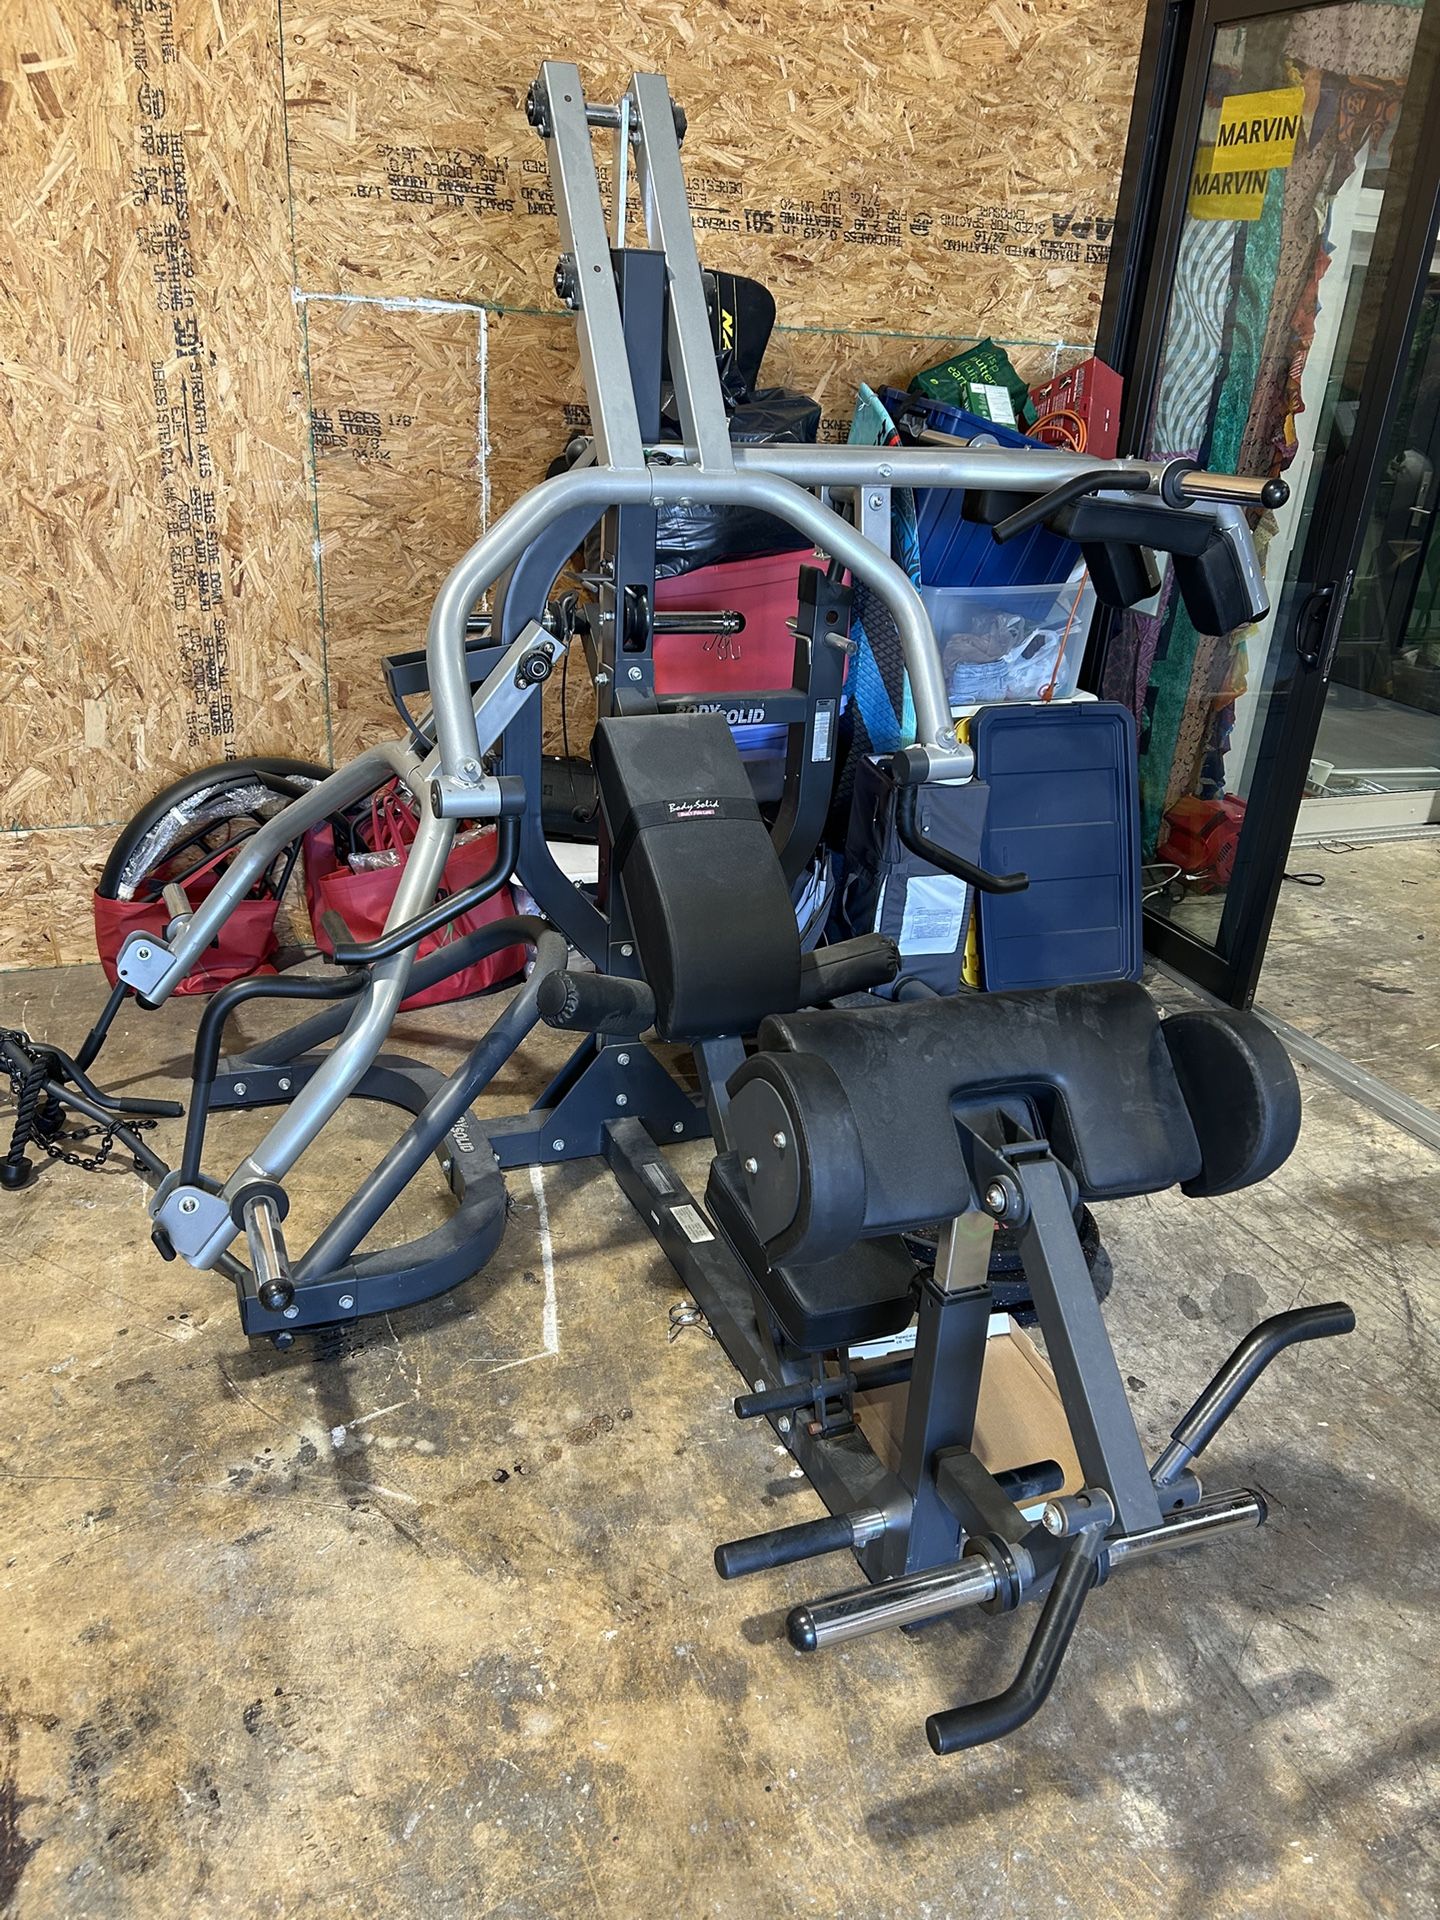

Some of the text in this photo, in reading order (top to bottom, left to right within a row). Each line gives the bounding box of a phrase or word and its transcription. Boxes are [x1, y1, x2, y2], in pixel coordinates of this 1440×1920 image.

[1217, 115, 1300, 147] MARVIN
[423, 163, 472, 179] BORDES
[1192, 170, 1268, 196] MARVIN
[691, 217, 741, 231] STRENGT
[940, 214, 984, 229] SPACING
[943, 239, 1000, 255] SHEATHING
[338, 410, 381, 424] EDGES
[198, 444, 211, 478] AXIS
[203, 492, 216, 524] THIS
[206, 531, 220, 565] SIDE
